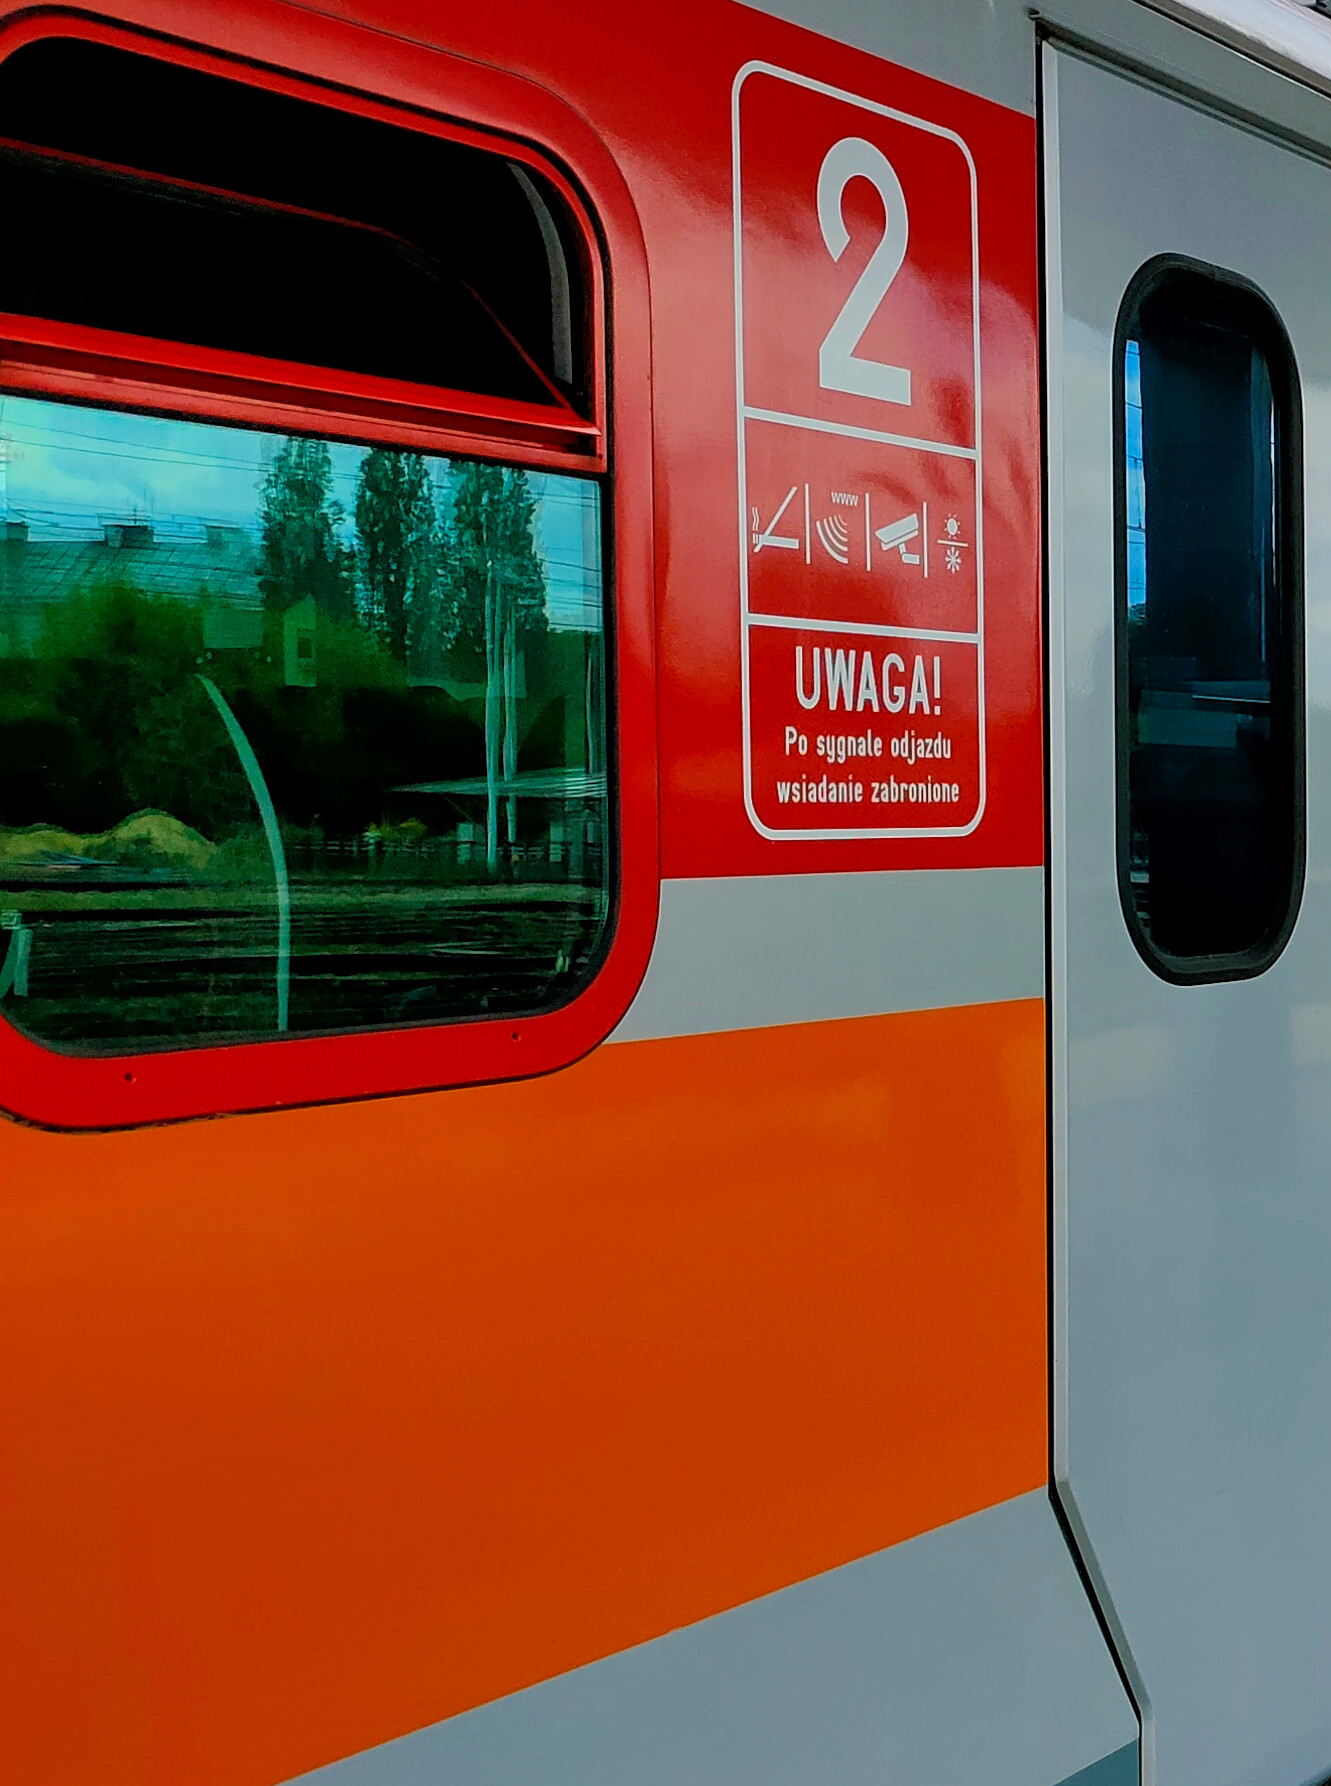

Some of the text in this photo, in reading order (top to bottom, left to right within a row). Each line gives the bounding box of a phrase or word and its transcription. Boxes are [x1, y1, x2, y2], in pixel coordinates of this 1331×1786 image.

[816, 136, 911, 406] 2
[795, 646, 941, 715] UWAGA!
[785, 725, 951, 764] Po sygnale odjazdu
[776, 774, 960, 804] wsiadanie zabronione
